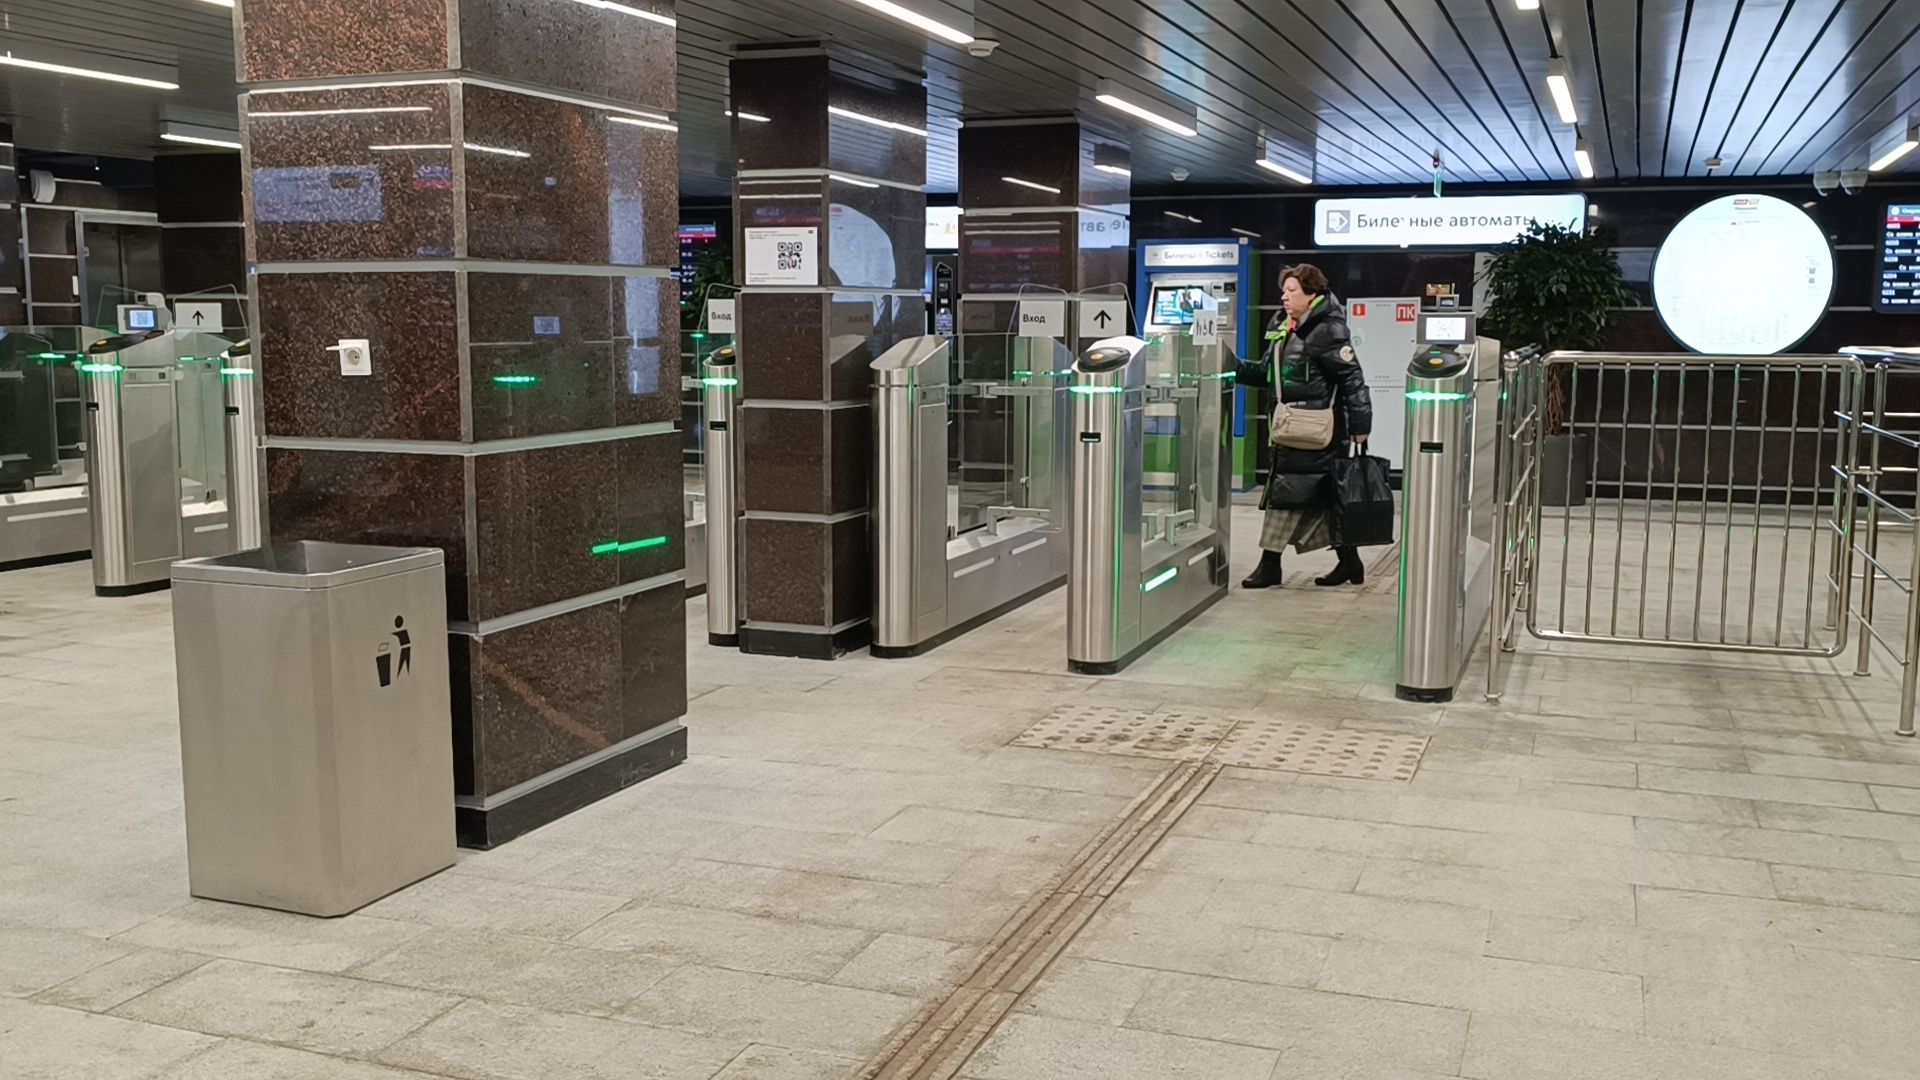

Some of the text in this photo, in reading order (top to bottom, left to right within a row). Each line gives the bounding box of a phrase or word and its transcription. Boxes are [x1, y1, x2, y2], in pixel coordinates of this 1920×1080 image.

[1357, 214, 1443, 228] Биленые
[711, 312, 732, 321] Вход
[1397, 305, 1415, 320] ПК
[1023, 314, 1046, 323] Вход
